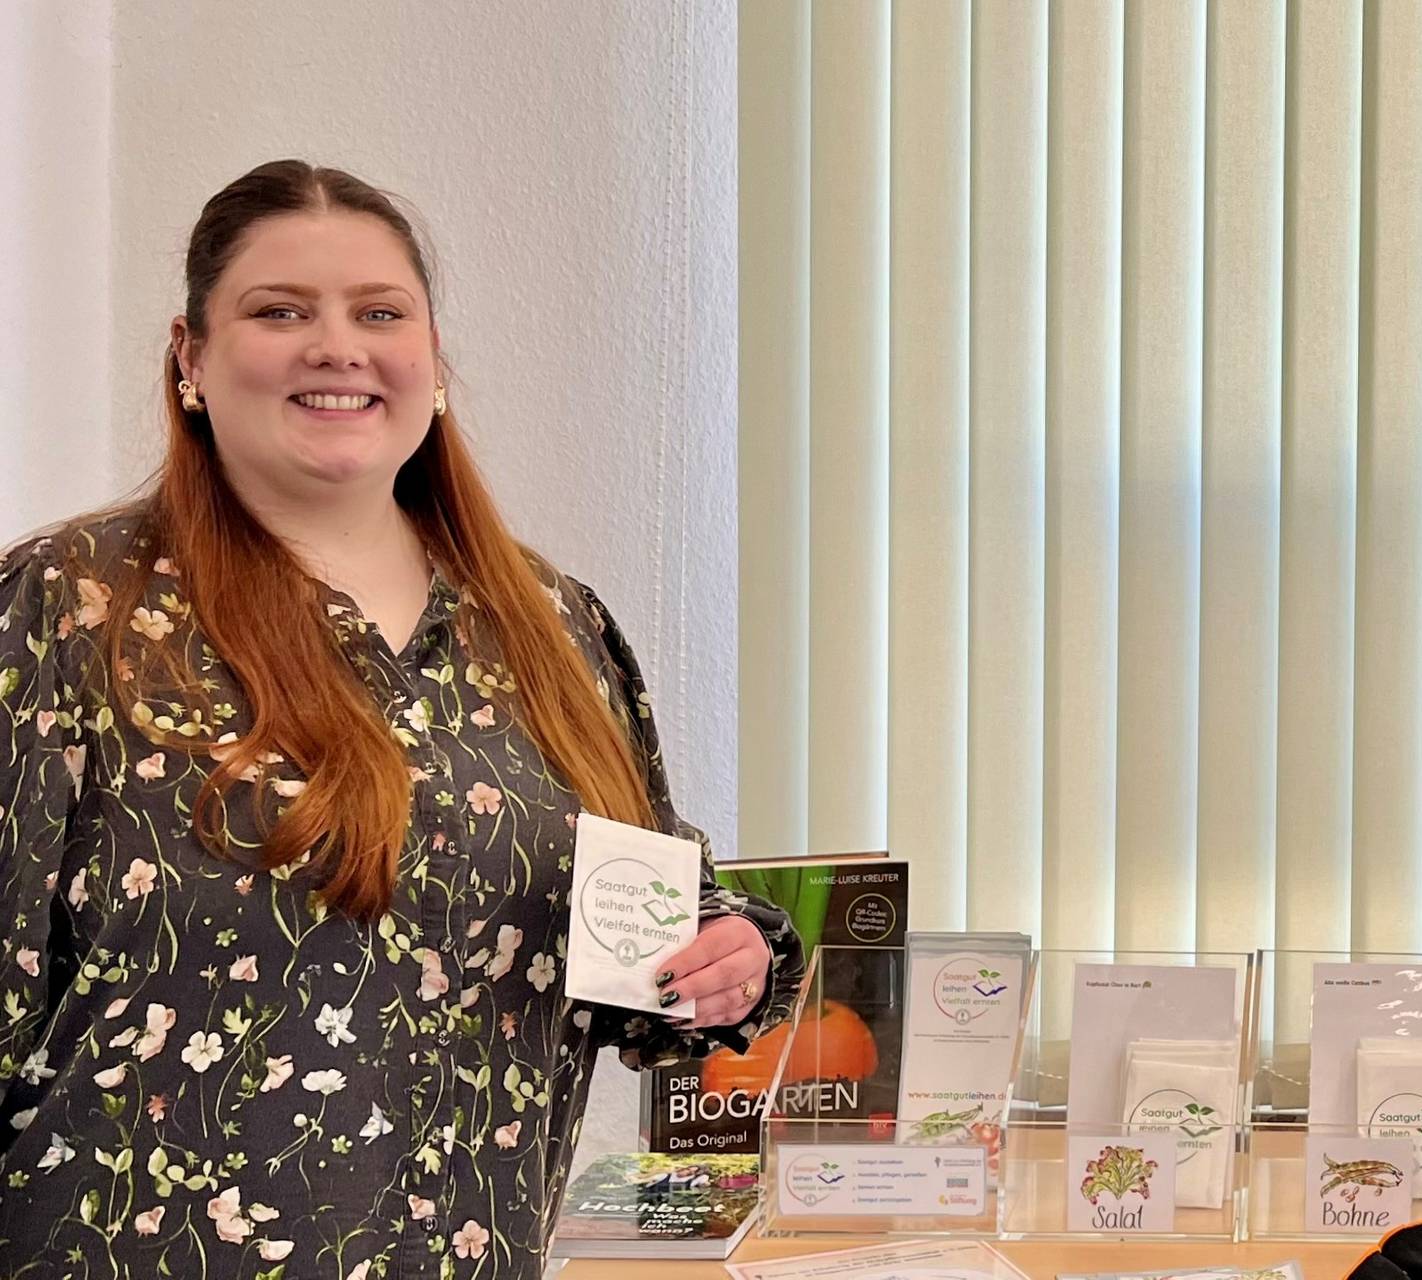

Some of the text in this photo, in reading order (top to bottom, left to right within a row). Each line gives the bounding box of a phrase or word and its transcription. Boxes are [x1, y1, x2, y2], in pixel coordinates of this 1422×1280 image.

[595, 878, 648, 897] Saatgut
[809, 873, 899, 886] MARIE-LUISE KREUTER
[595, 897, 634, 914] leihen
[594, 916, 680, 944] Vielfalt ernten
[942, 985, 967, 993] leihen
[669, 1076, 699, 1092] DER
[669, 1081, 858, 1124] BIOGARTEN
[1141, 1107, 1183, 1120] Saatgut
[1379, 1113, 1421, 1124] Saatgut
[670, 1131, 747, 1150] Das Original
[1379, 1130, 1410, 1138] leihen
[578, 1201, 726, 1213] Hochbeet
[1322, 1201, 1390, 1227] Bohne
[1092, 1204, 1143, 1229] Salat
